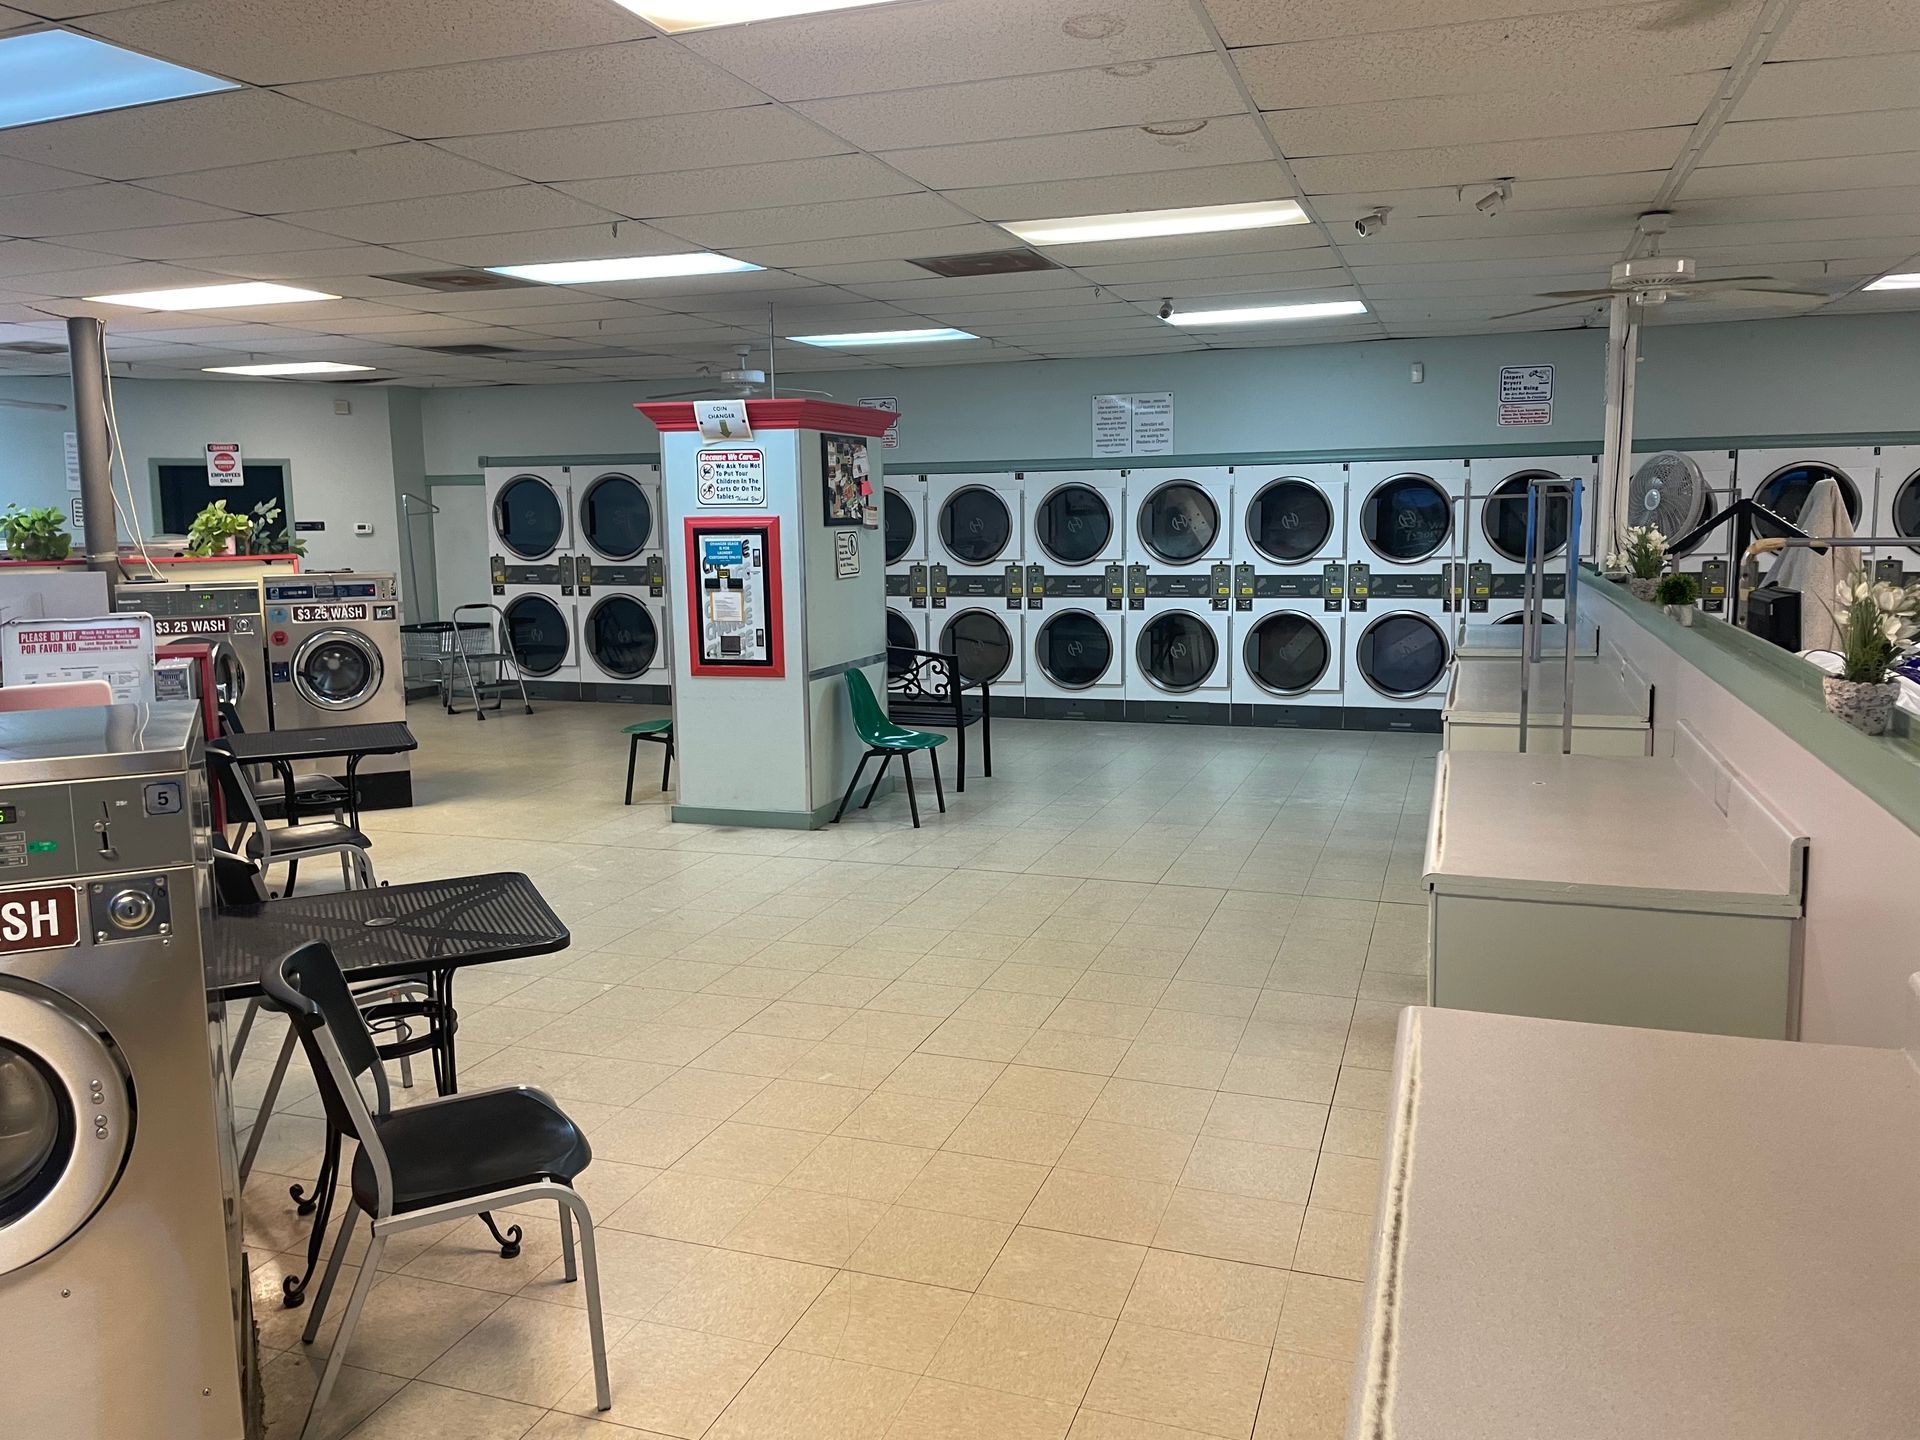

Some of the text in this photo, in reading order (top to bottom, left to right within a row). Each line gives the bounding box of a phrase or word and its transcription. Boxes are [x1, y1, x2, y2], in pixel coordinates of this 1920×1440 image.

[296, 606, 363, 620] $3.25 WASH
[156, 619, 226, 634] $3.25 WASH
[20, 631, 78, 643] PLEASE DO NOT
[21, 642, 77, 655] POR FAVOR NO
[158, 791, 169, 806] 5
[0, 899, 59, 941] SH
